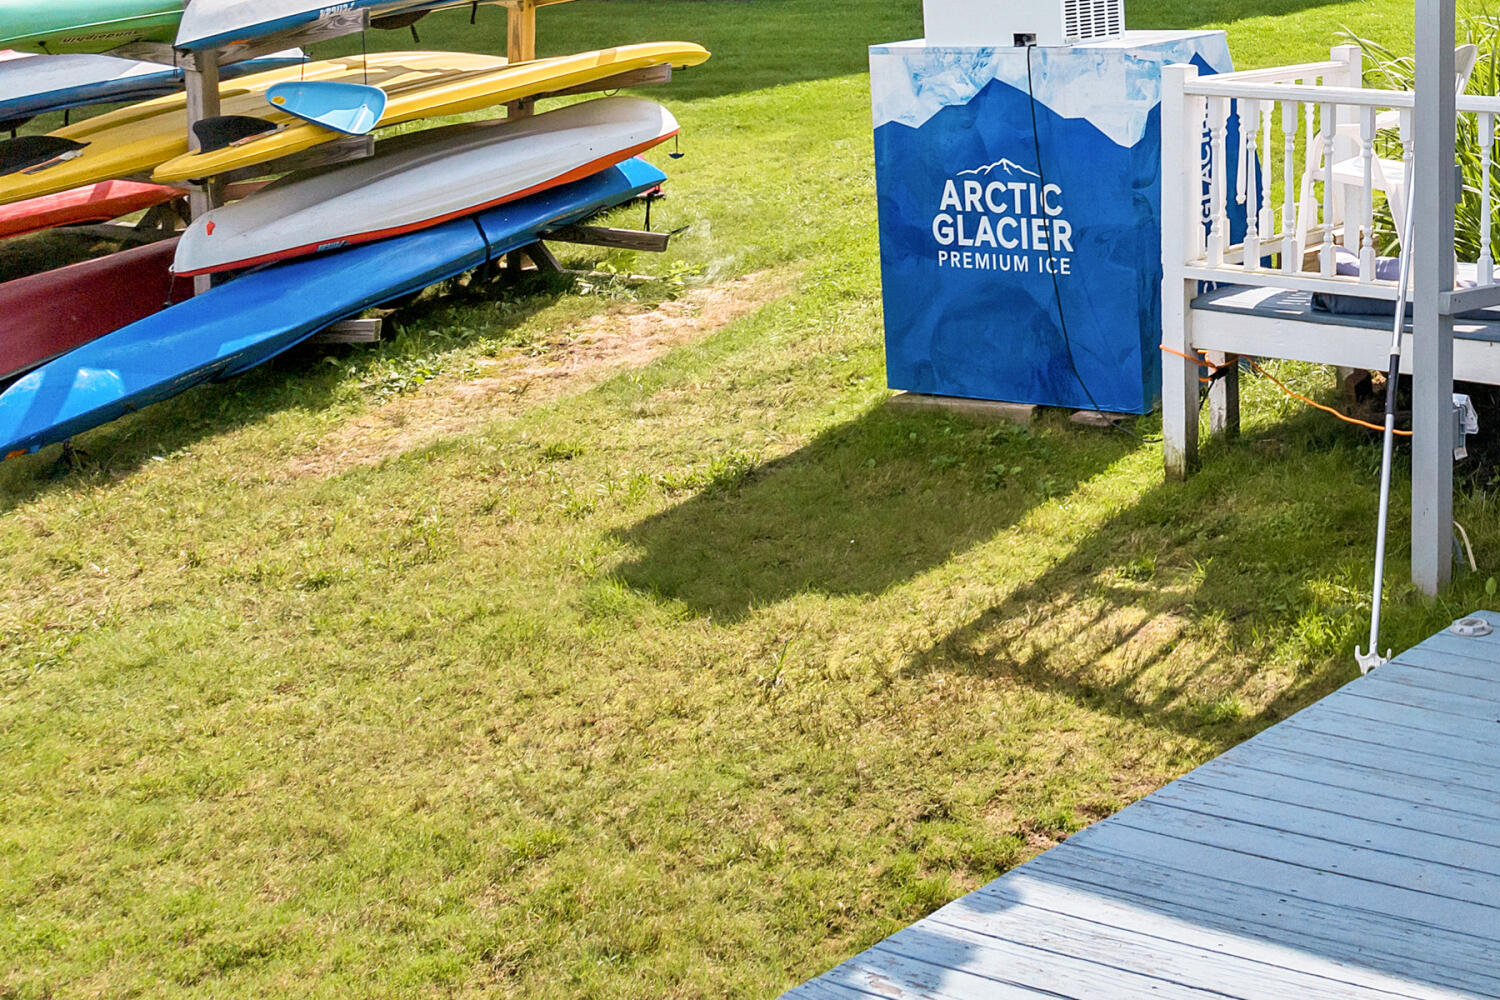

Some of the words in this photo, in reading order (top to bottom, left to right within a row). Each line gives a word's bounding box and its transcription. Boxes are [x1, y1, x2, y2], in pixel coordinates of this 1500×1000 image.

[939, 179, 1063, 217] ARCTIC
[932, 213, 1074, 252] GLACIER
[938, 250, 1029, 272] PREMIUM
[1038, 256, 1071, 275] ICE
